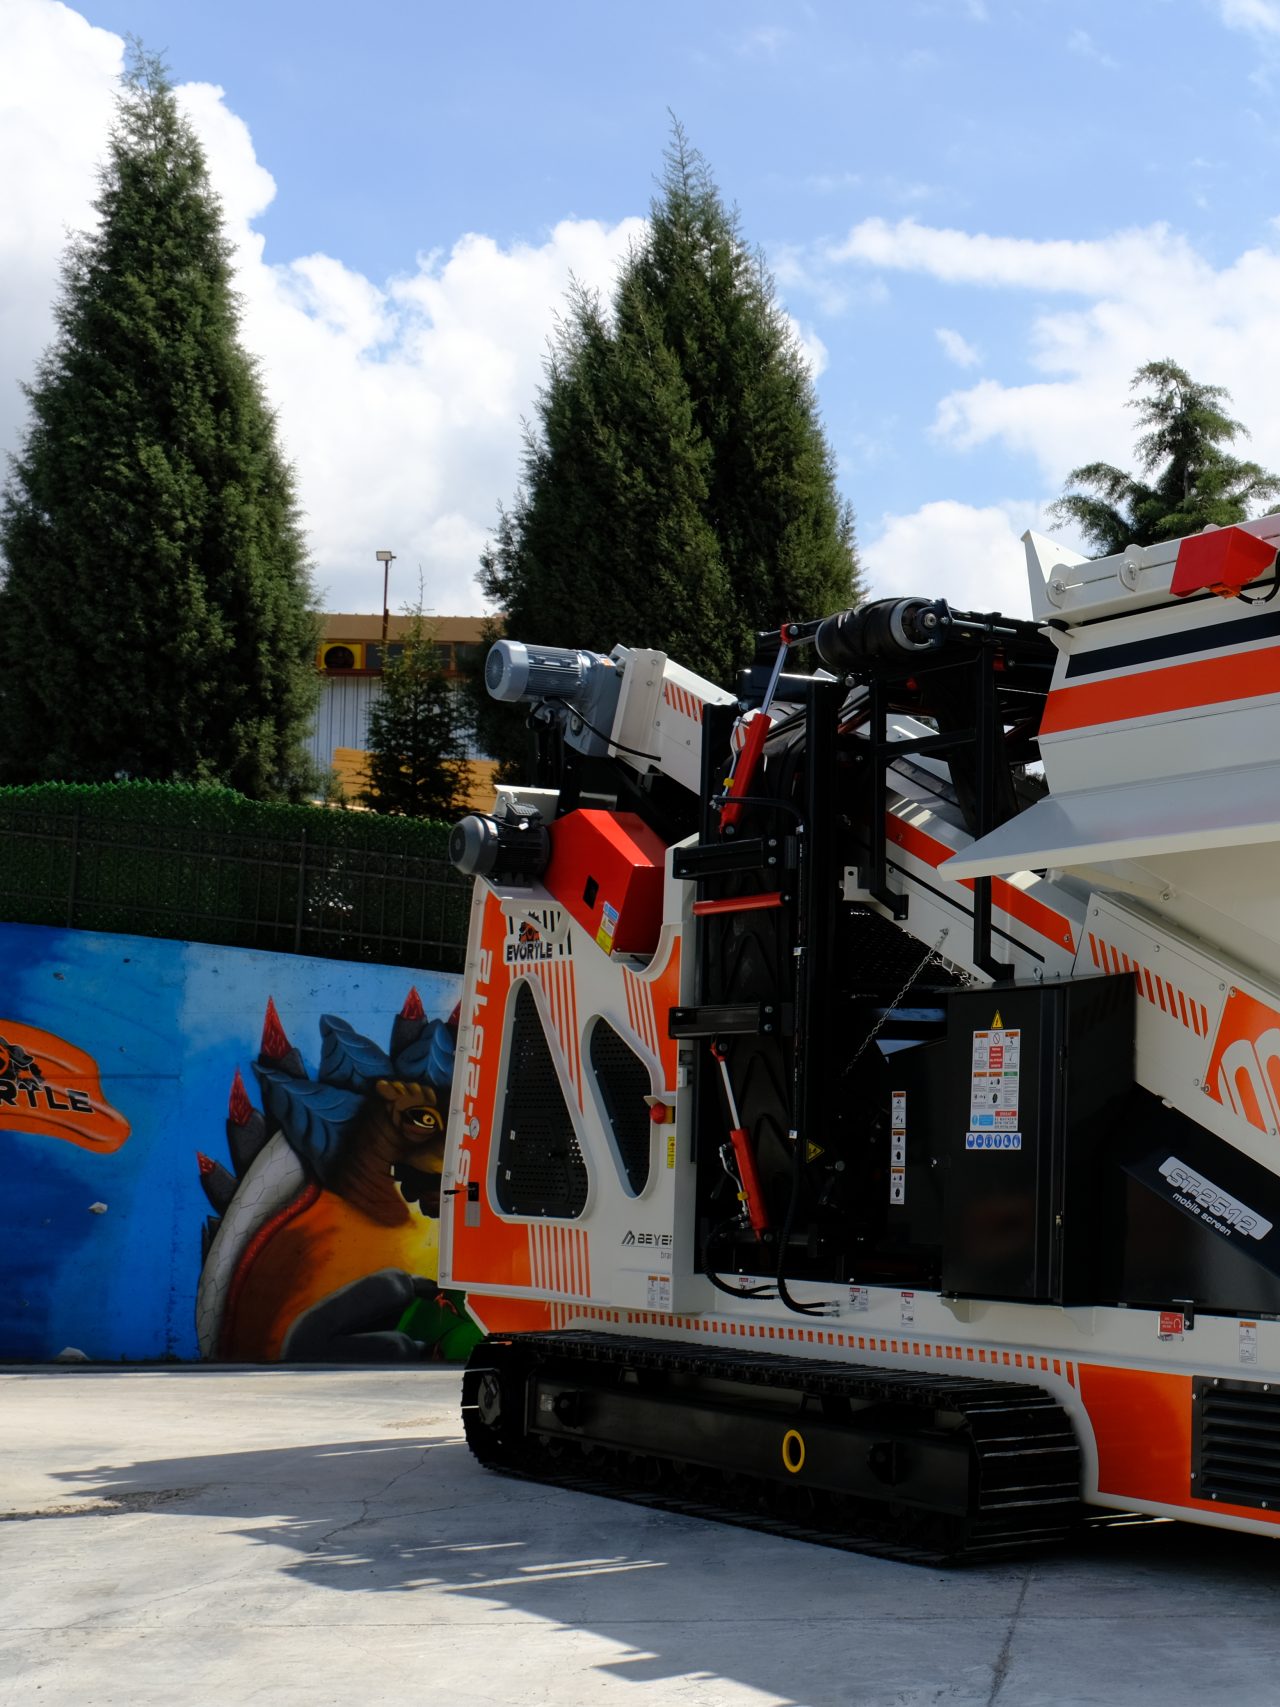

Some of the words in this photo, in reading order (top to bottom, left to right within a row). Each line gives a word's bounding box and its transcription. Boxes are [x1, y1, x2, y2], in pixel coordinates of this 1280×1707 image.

[506, 942, 553, 962] EVORTLE
[1166, 1167, 1258, 1236] ST-2512
[1172, 1192, 1201, 1215] mobile
[1200, 1212, 1232, 1237] screen
